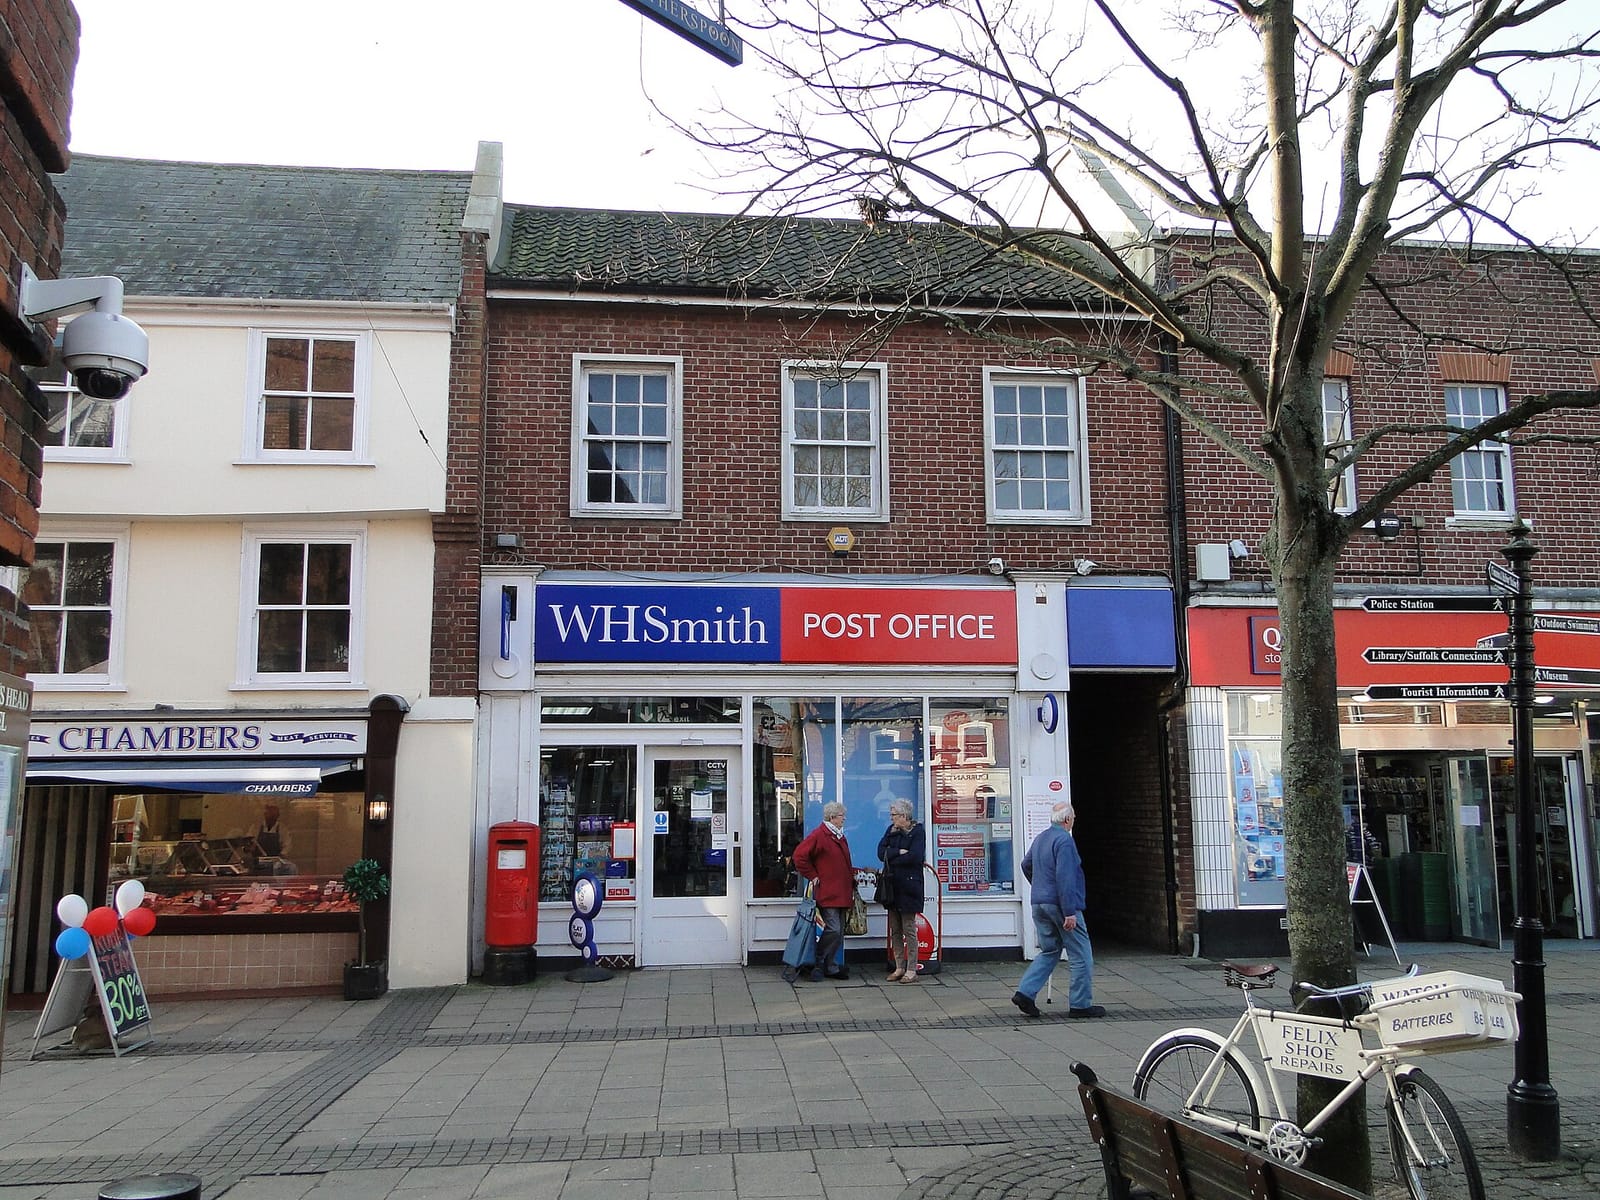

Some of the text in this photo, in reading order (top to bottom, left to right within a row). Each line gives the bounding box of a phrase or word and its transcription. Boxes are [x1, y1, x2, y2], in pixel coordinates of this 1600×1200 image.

[650, 0, 740, 54] HERSPOON
[1371, 600, 1434, 609] Police Station
[548, 604, 769, 644] WHSmith
[803, 613, 995, 639] POST OFFICE
[1540, 618, 1599, 632] Outdoor Swimming
[1371, 651, 1494, 662] Library/Suffolk Connexions
[1542, 670, 1569, 681] Museum
[5, 687, 29, 710] HEAD
[1400, 686, 1490, 697] Tourist Information
[59, 726, 262, 752] CHAMBERS
[309, 733, 348, 741] SERVICES
[245, 783, 313, 794] CHAMBERS
[1392, 1012, 1454, 1032] BATTERIES
[1282, 1025, 1338, 1047] FELIX
[1285, 1041, 1335, 1061] SHOE
[1280, 1055, 1343, 1075] REPAIRS
